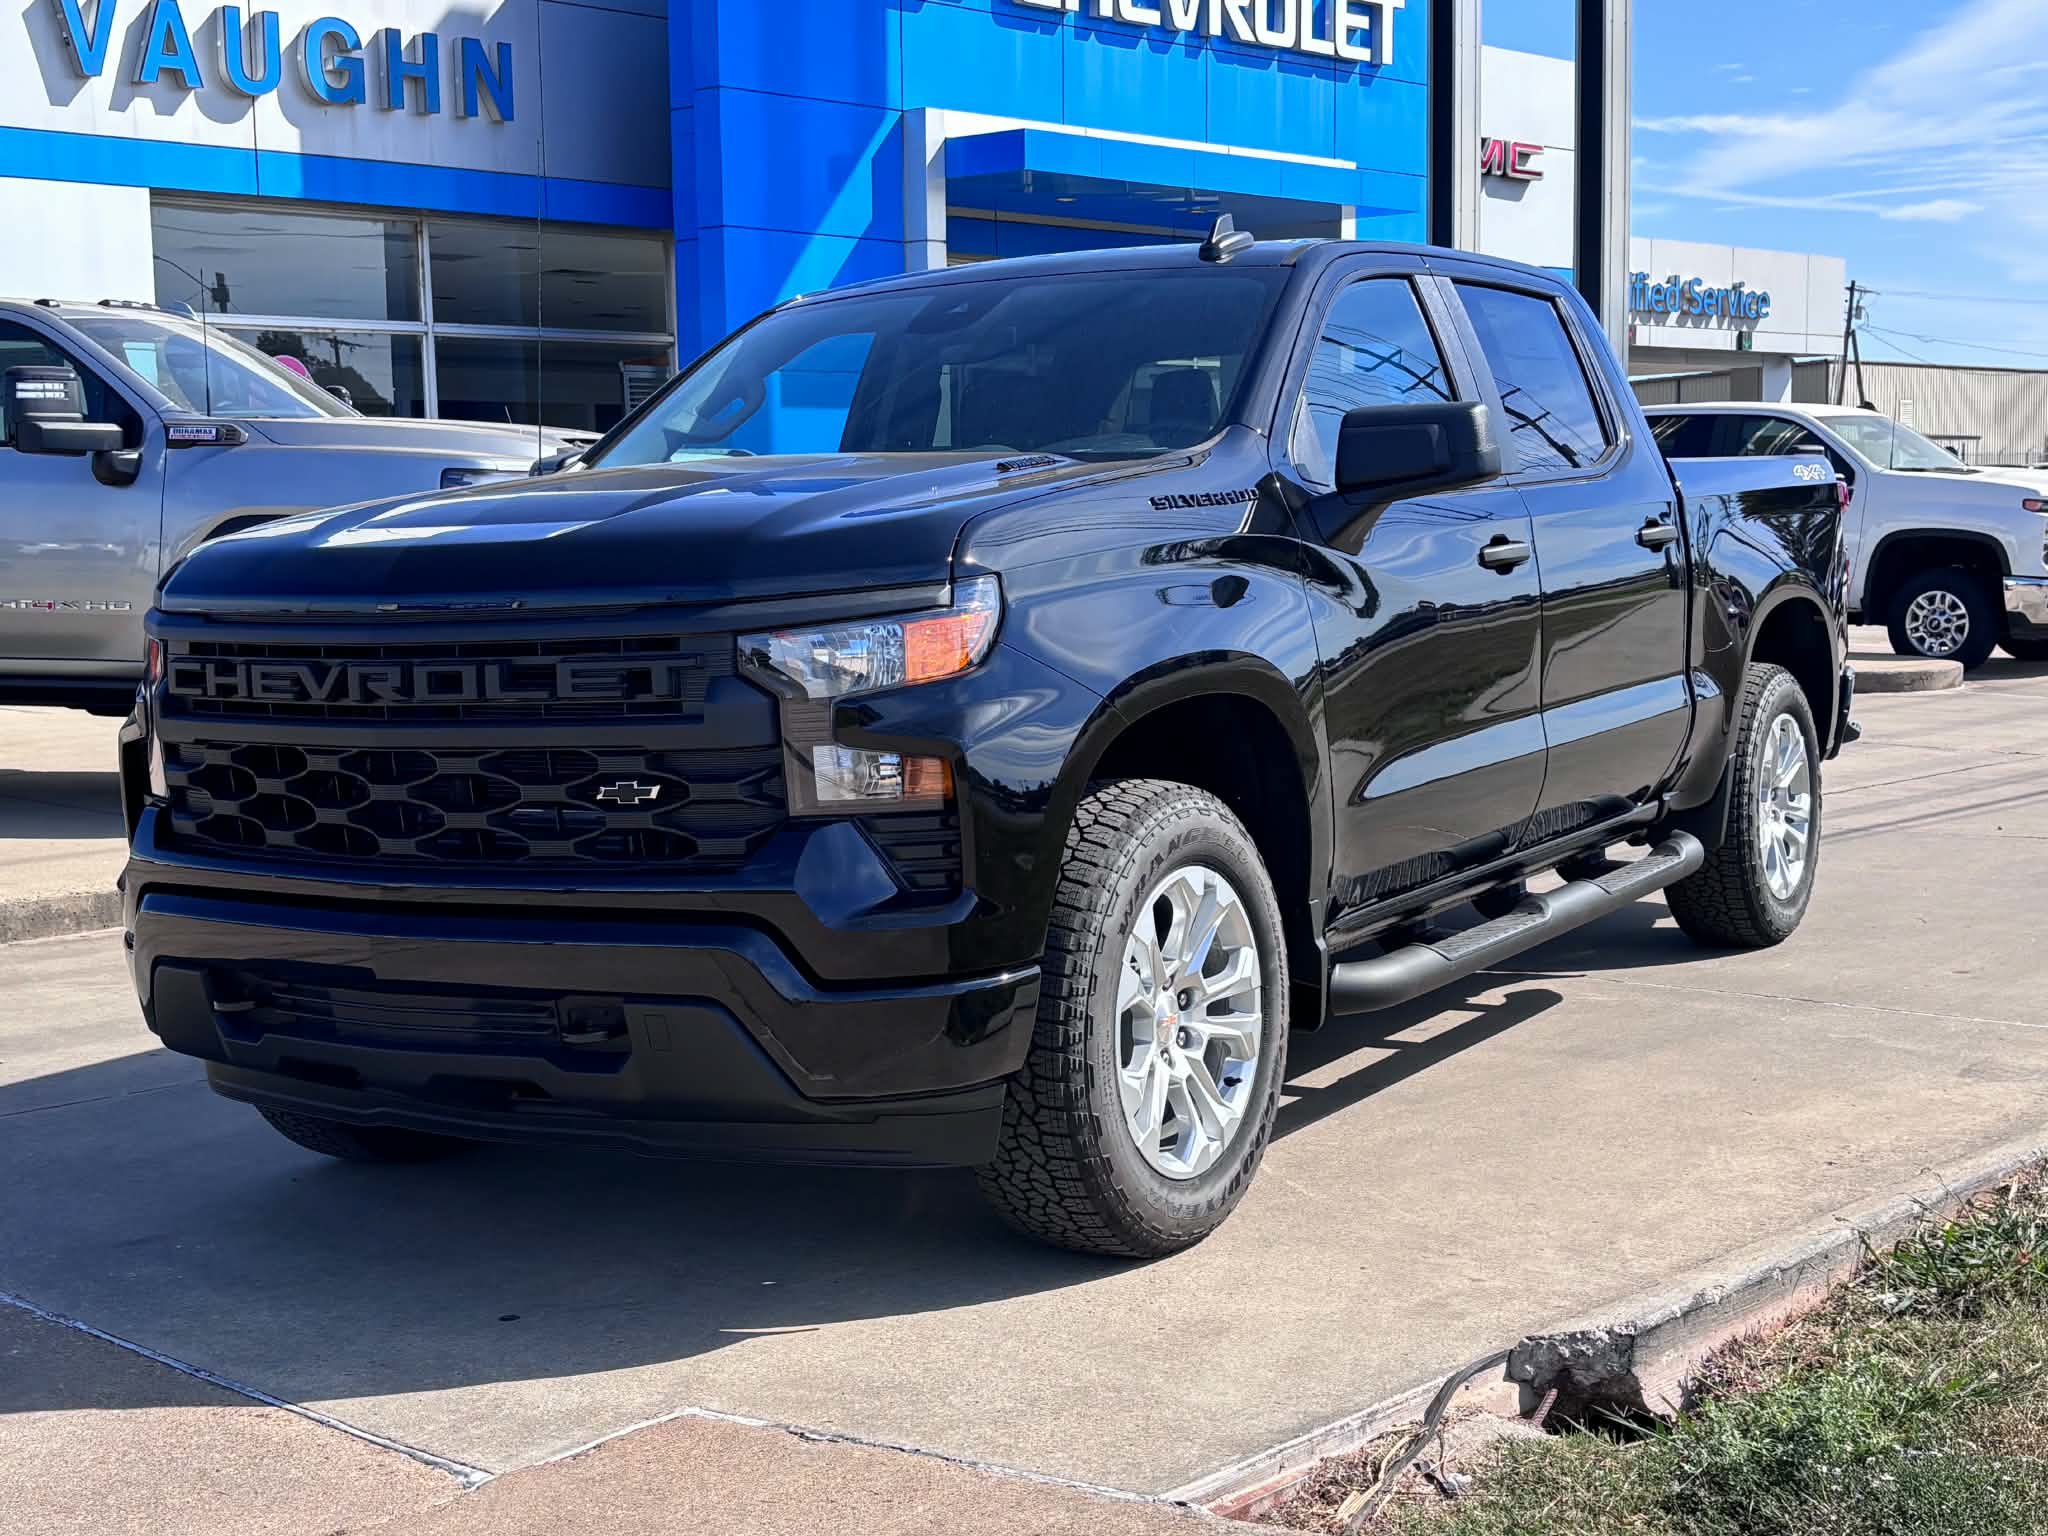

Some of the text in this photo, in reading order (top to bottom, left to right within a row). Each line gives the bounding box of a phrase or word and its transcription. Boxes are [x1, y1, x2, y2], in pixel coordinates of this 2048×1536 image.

[1013, 0, 1405, 65] ROLET
[55, 0, 515, 121] VAUGHN
[1688, 276, 1771, 319] Service
[1149, 488, 1259, 511] SILVERADO
[168, 658, 699, 703] CHEVROLET
